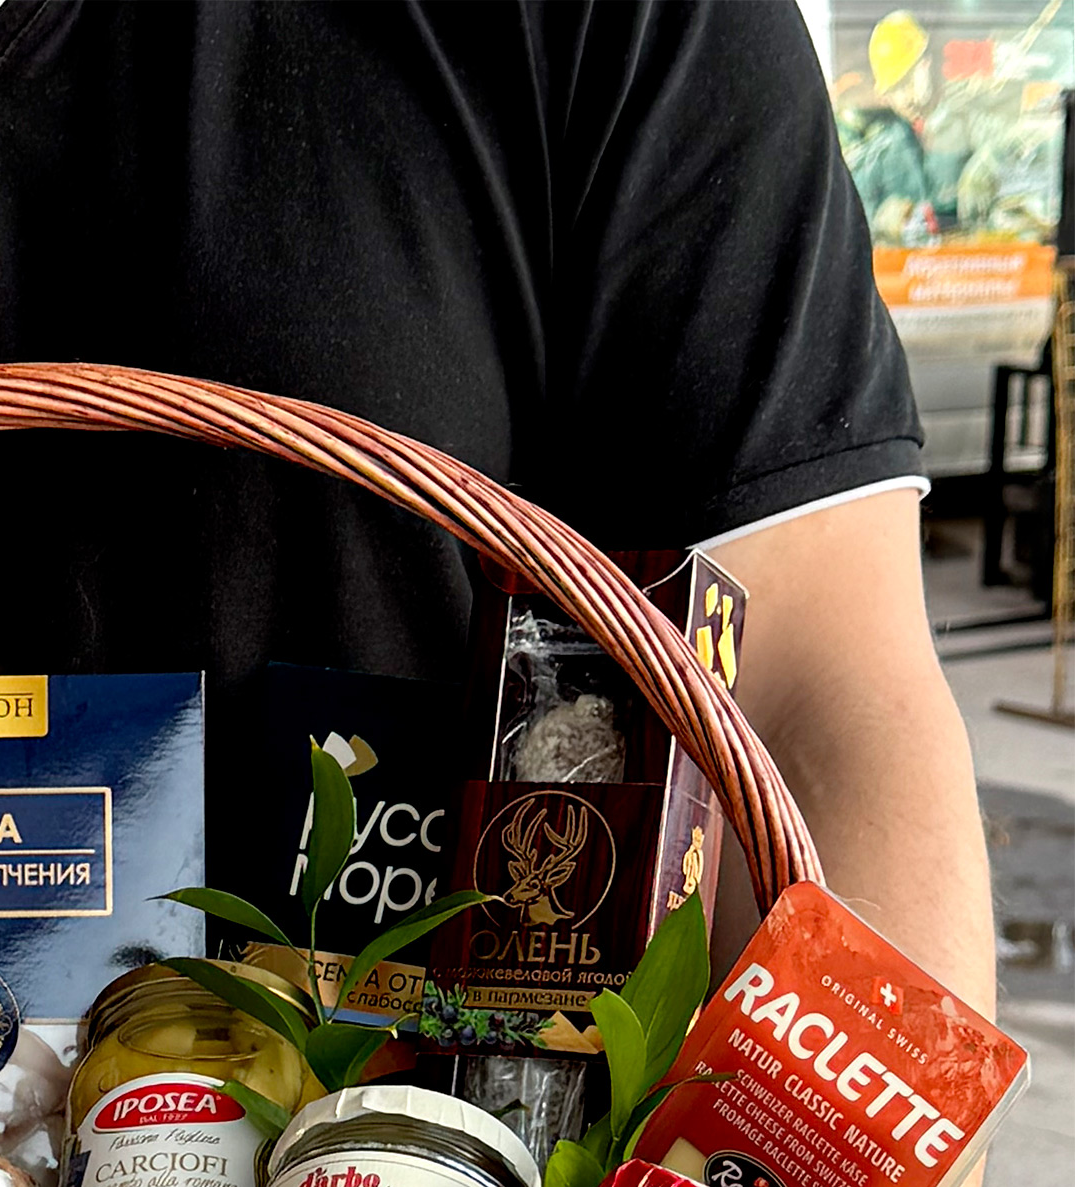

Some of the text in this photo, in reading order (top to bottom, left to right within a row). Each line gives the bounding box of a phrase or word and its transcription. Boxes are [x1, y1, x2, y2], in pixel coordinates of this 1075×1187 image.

[469, 930, 601, 965] ОЛЕНЬ
[487, 991, 587, 1007] пармезане
[821, 975, 928, 1065] ORIGINAL SWISS
[113, 1092, 217, 1121] IPOSEA
[723, 962, 966, 1168] RACLETTE
[727, 1028, 906, 1183] NATUR CLASSIC NATURE
[694, 1061, 748, 1106] RALETTE
[745, 1101, 785, 1140] CHEESE
[784, 1134, 815, 1163] FROM
[712, 1098, 766, 1146] FROMAGE
[762, 1142, 812, 1187] RACLETTE
[736, 1069, 794, 1124] SCHWEIZER
[793, 1117, 841, 1164] RACLETTE
[95, 1152, 228, 1183] CARCIOFI
